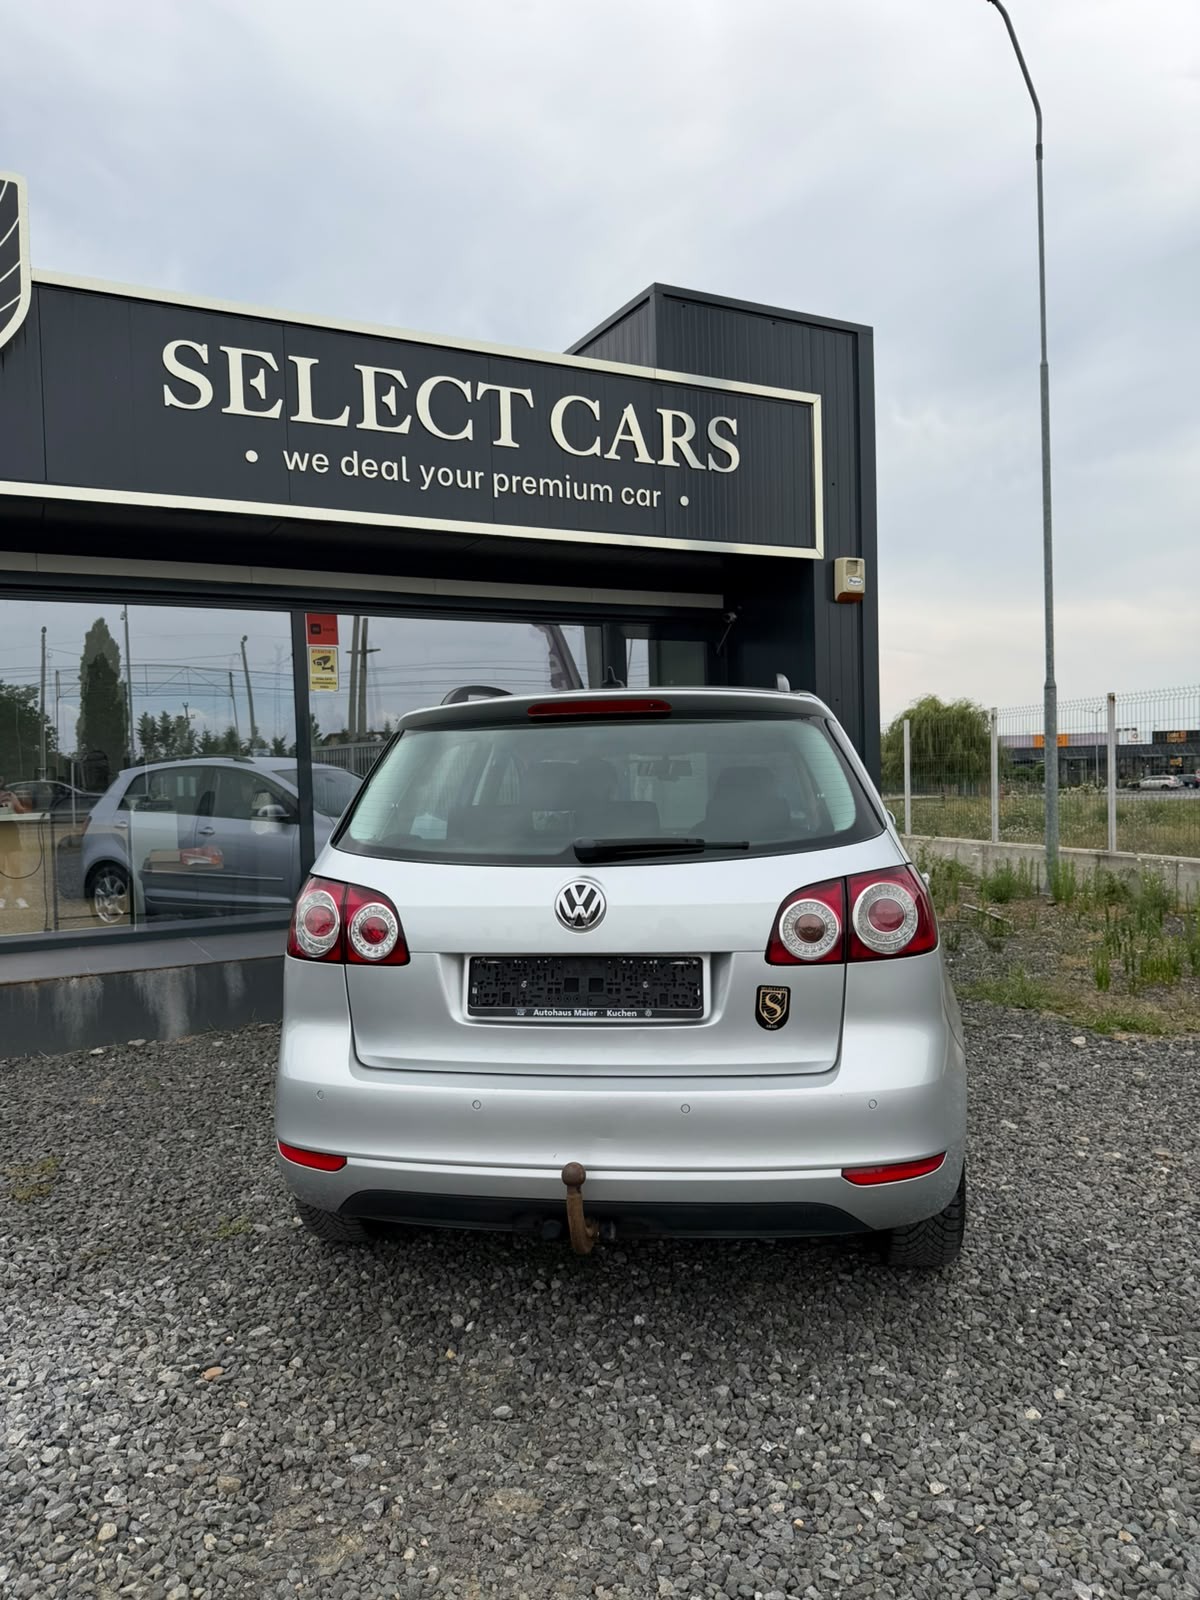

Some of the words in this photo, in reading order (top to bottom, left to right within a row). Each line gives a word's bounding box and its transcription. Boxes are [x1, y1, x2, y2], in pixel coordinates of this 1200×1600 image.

[162, 338, 535, 449] SELECT
[550, 395, 741, 474] CARS
[283, 451, 330, 474] we
[340, 454, 411, 484] deal
[419, 464, 485, 491] your
[493, 470, 614, 503] premium
[621, 486, 663, 507] car
[533, 1008, 572, 1017] Autohaus
[573, 1008, 598, 1017] Maier
[606, 1009, 638, 1017] Kuchen
